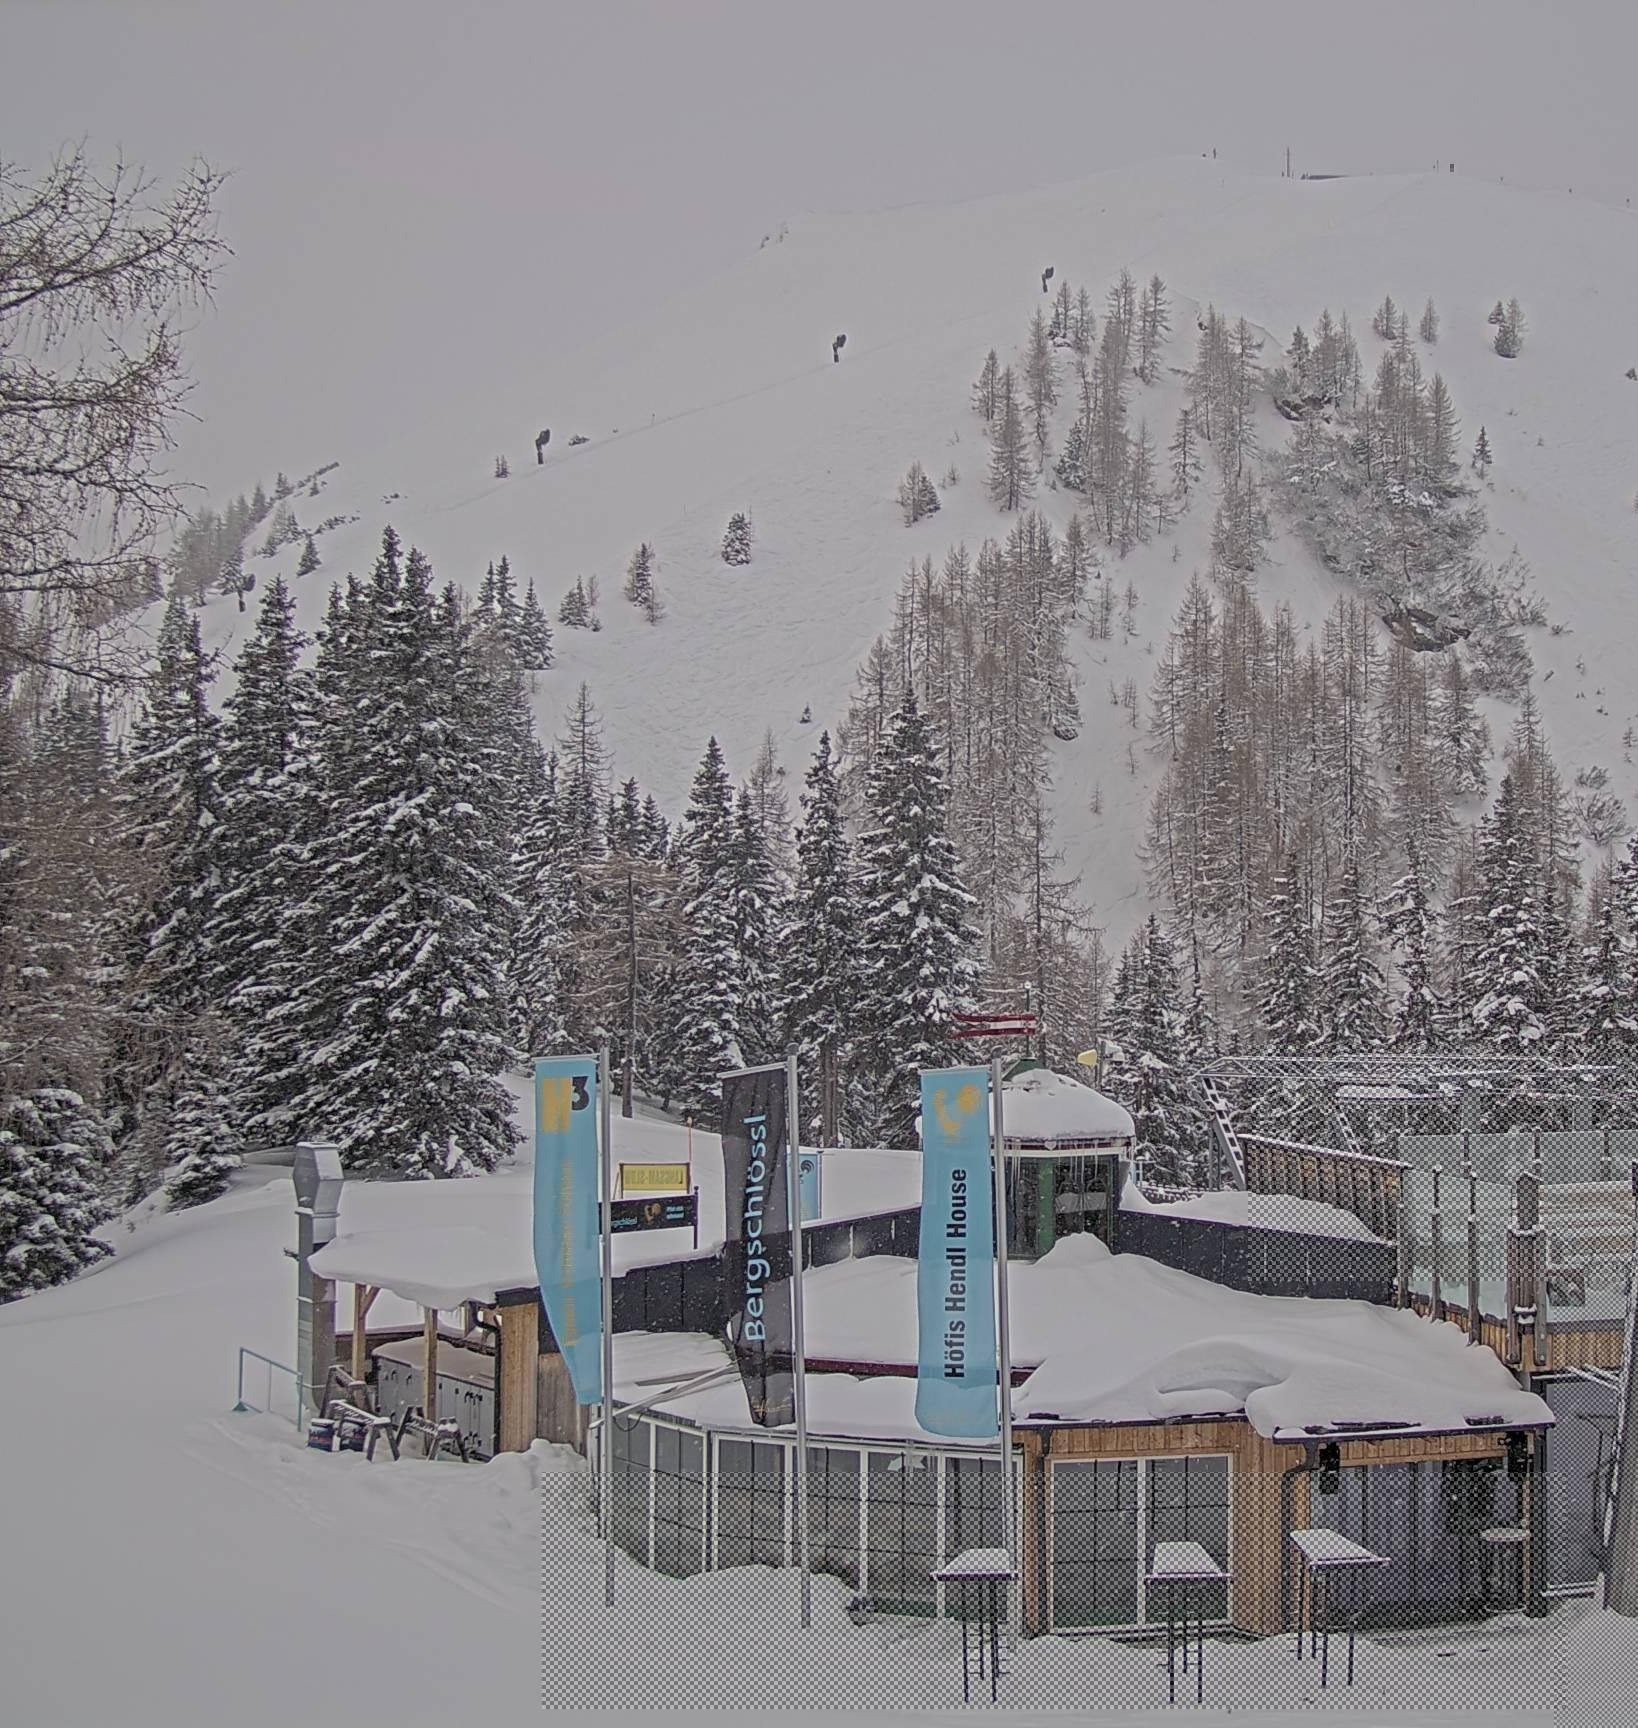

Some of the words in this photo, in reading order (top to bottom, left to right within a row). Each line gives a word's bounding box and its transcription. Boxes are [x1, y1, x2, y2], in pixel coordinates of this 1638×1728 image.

[743, 1113, 770, 1342] Bergschlössl
[946, 1168, 967, 1238] House
[945, 1247, 967, 1312] Hendl
[944, 1320, 966, 1378] Höfis
